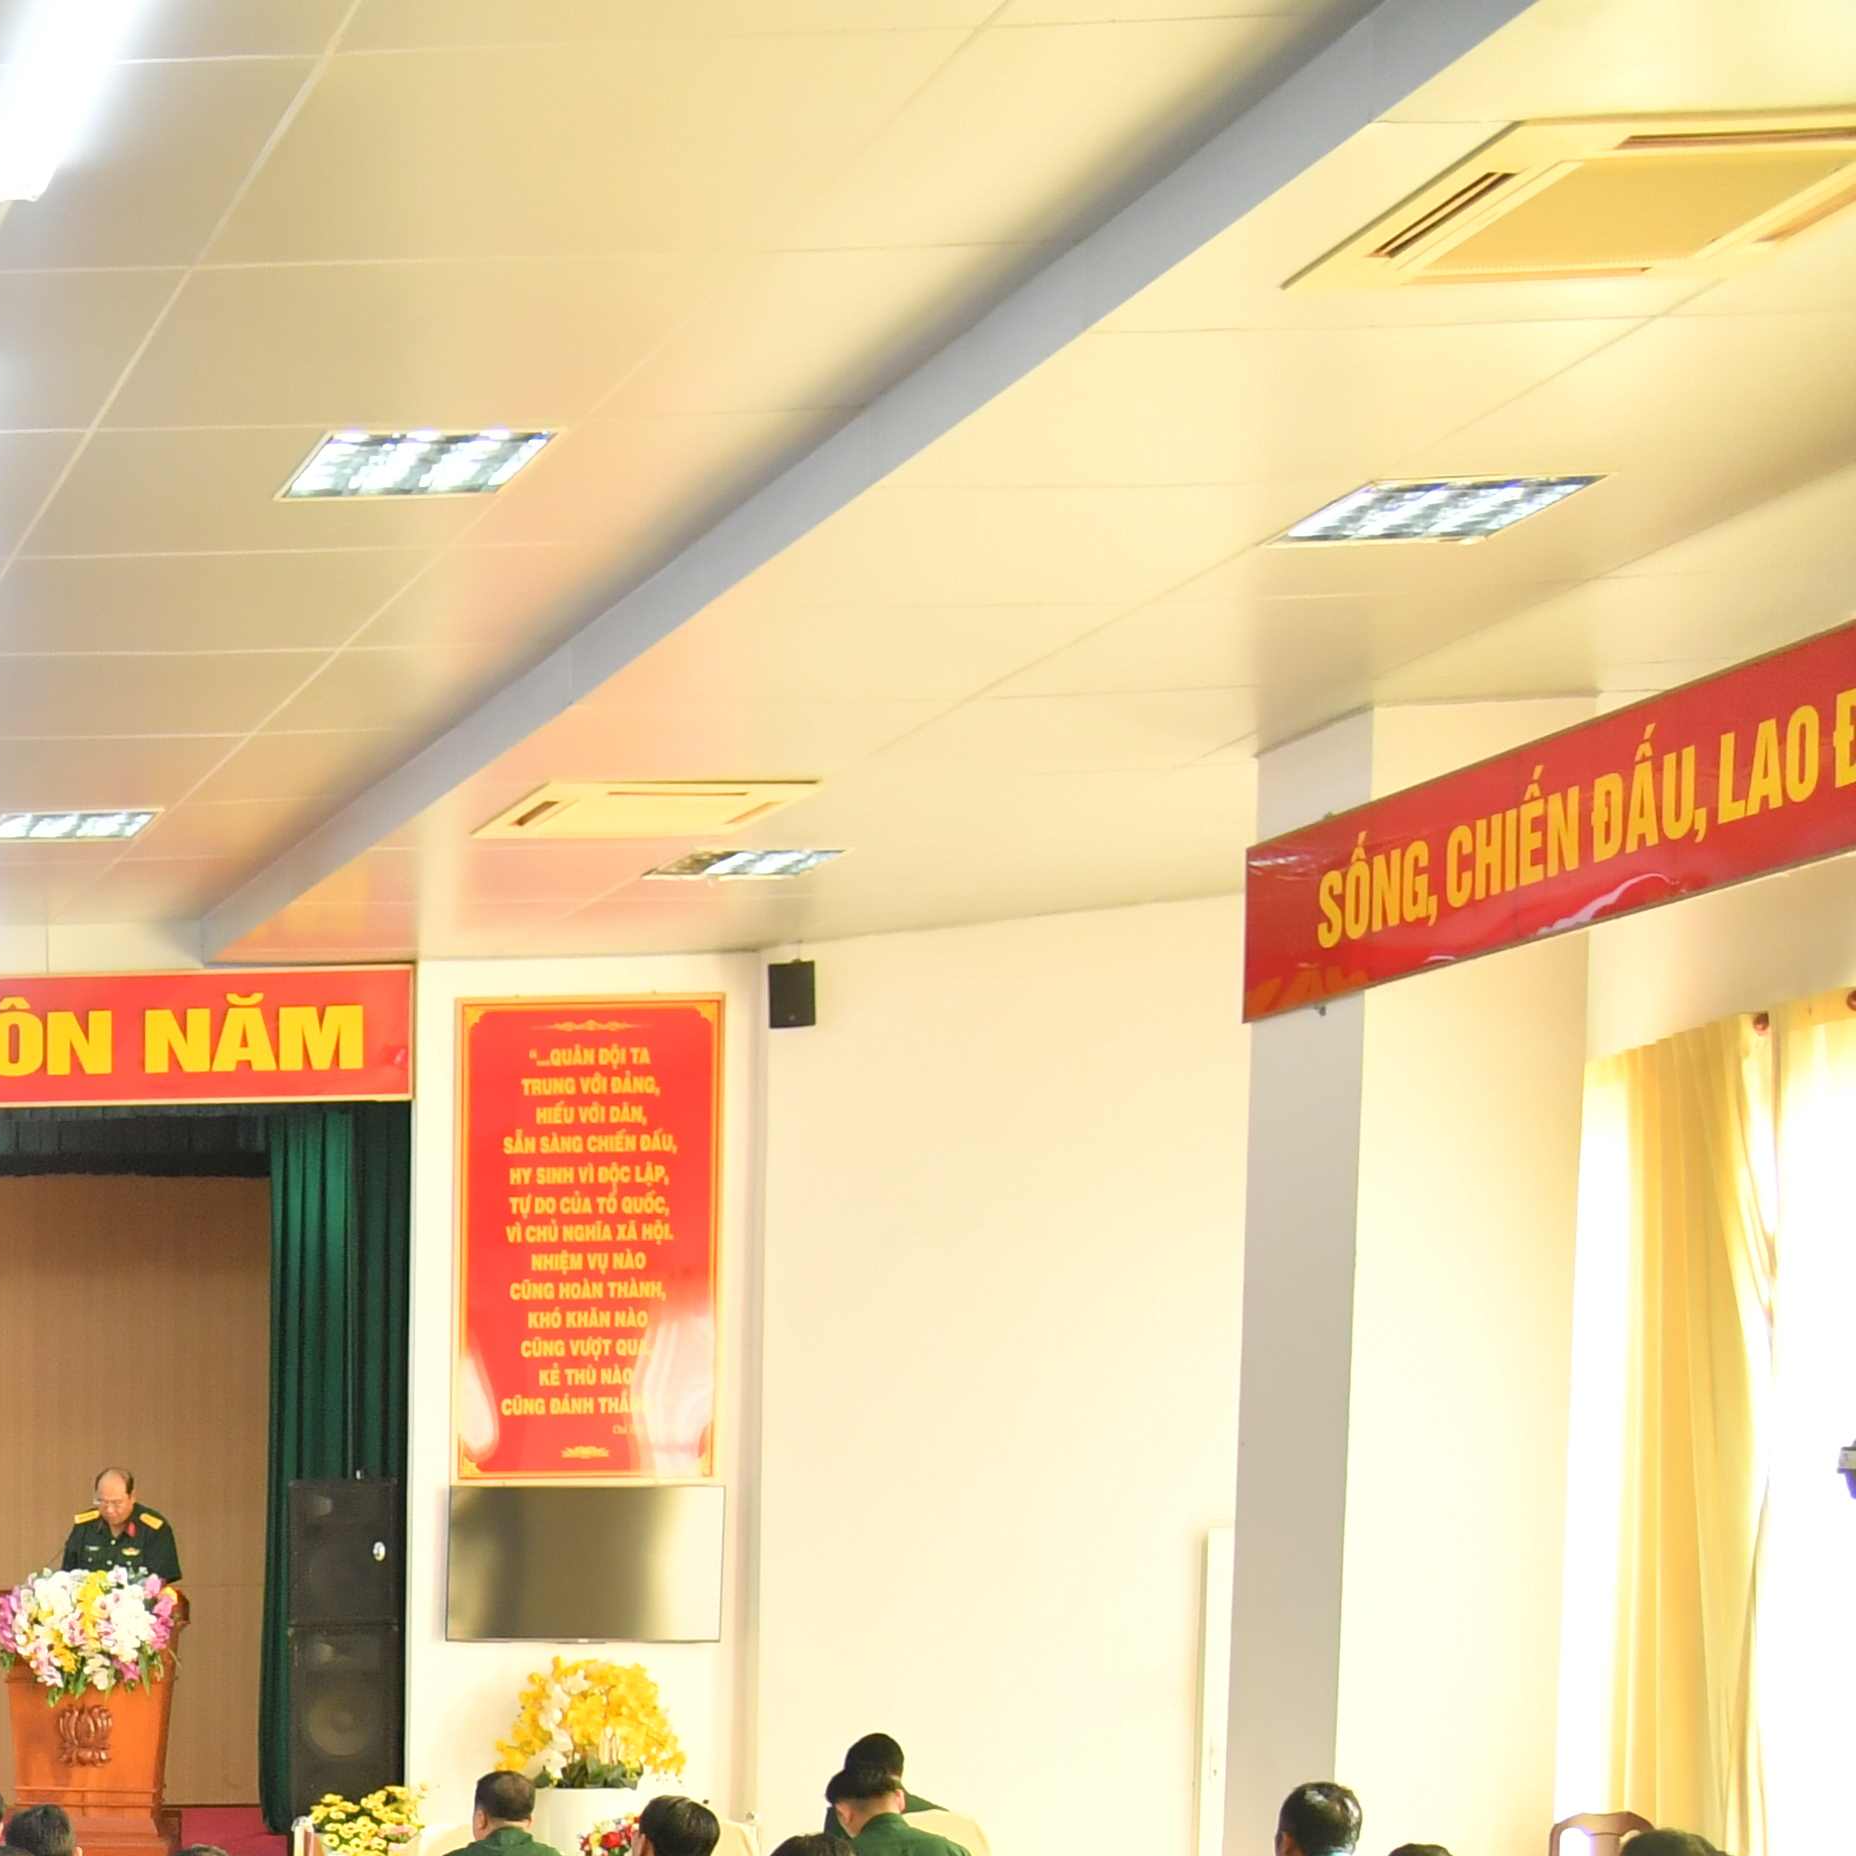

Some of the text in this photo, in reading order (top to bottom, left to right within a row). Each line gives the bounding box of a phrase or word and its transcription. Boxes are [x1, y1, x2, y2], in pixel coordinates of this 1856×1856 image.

[1317, 830, 1438, 950] SỐNG,
[1446, 765, 1580, 910] CHIẾN
[1591, 723, 1707, 863] ĐẤU,
[1717, 704, 1820, 825] LAO
[144, 991, 365, 1075] NĂM
[598, 1044, 626, 1070] ĐỘI
[630, 1047, 651, 1064] TA
[521, 1070, 660, 1096] TRUNG VỚI ĐẢNG,
[536, 1100, 646, 1126] HIẾU VỚI DÂN,
[540, 1132, 583, 1153] SÀNG
[588, 1129, 636, 1152] CHIẾN
[640, 1128, 677, 1154] ĐẤU,
[510, 1167, 531, 1184] HY
[536, 1167, 574, 1184] SINH
[578, 1163, 594, 1184] VÌ
[635, 1162, 669, 1187] LẬP,
[534, 1197, 555, 1214] DO
[560, 1191, 592, 1214] CỦA
[622, 1190, 670, 1216] QUỐC,
[506, 1222, 521, 1243] VÌ
[526, 1219, 558, 1242] CHỦ
[563, 1220, 612, 1242] NGHĨA
[617, 1220, 637, 1240] XÃ
[532, 1249, 646, 1275] NHIỆM VỤ NÀO
[510, 1277, 666, 1301] CŨNG HOÀN THÀNH,
[528, 1307, 648, 1328] KHÓ KHĂN NÀO
[521, 1337, 565, 1358] CŨNG
[564, 1364, 596, 1386] THÙ
[501, 1395, 545, 1416] CŨNG
[550, 1394, 594, 1414] ĐÁNH
